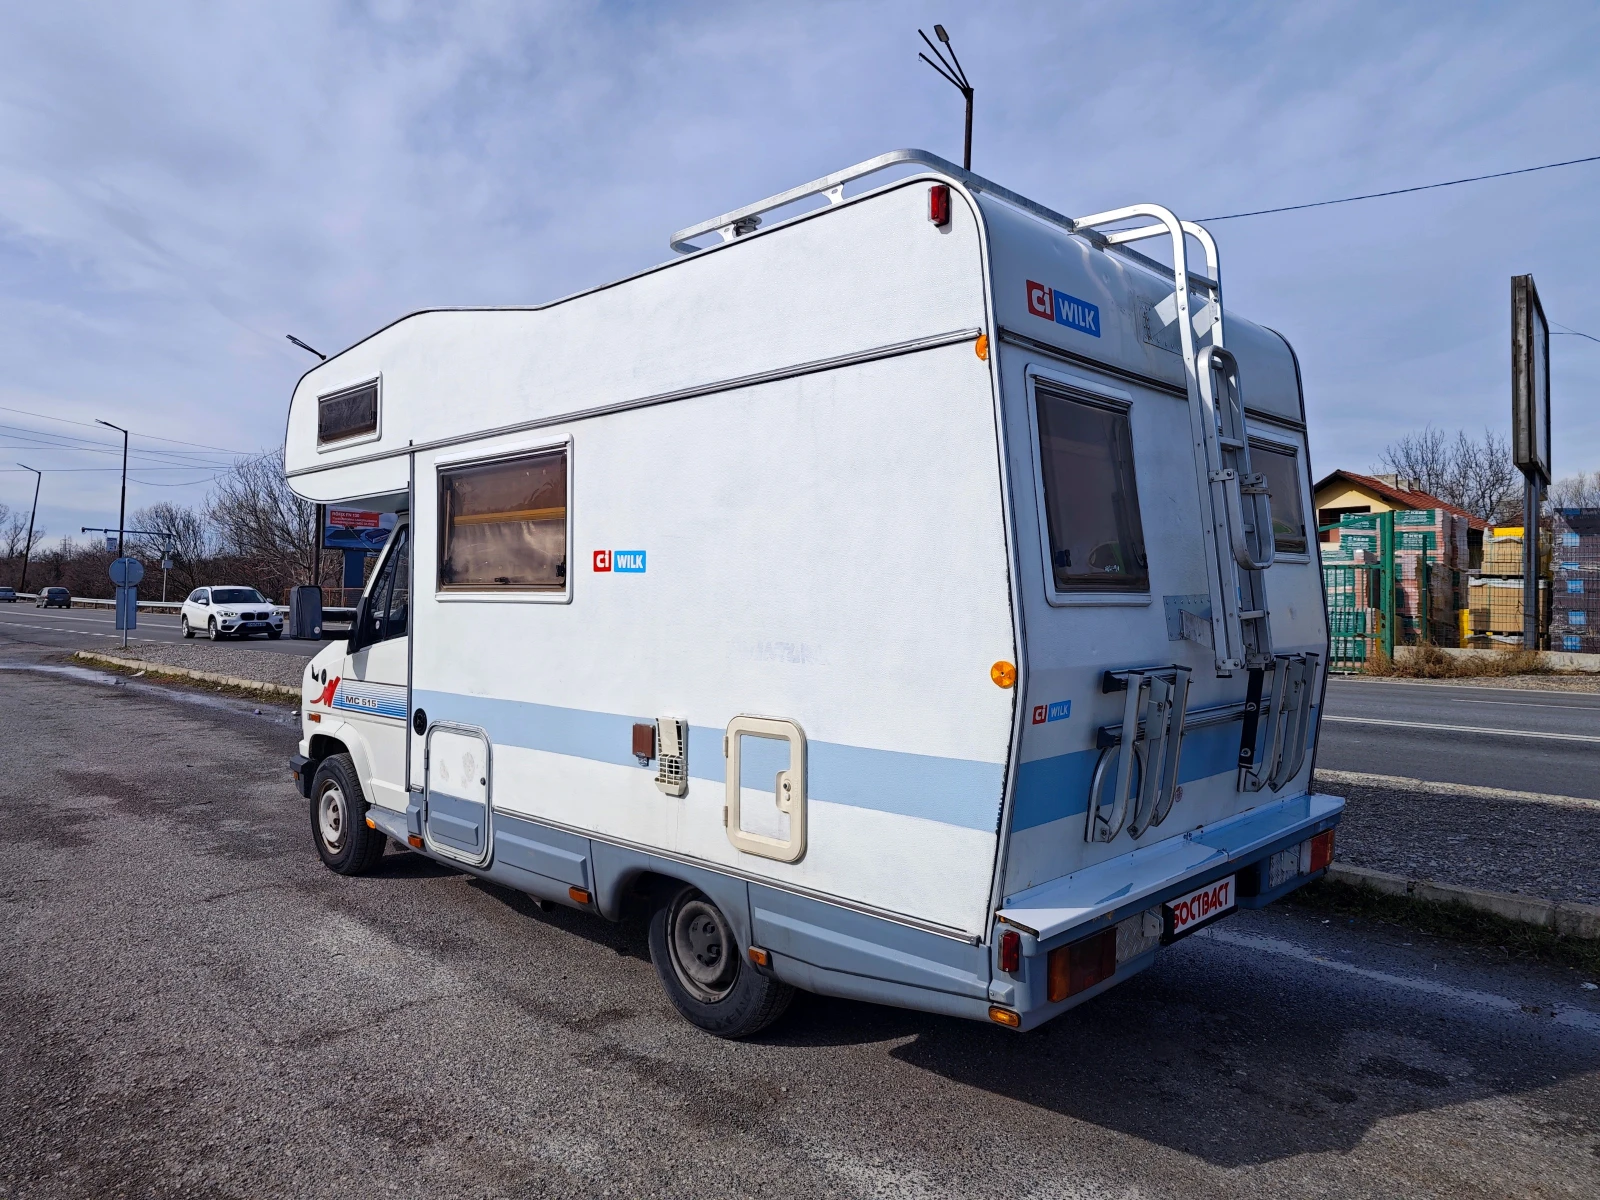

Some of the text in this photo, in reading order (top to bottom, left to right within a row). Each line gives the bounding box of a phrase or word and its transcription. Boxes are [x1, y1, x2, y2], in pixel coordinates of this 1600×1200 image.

[1058, 297, 1096, 331] WILK
[616, 554, 644, 569] WILK
[345, 695, 377, 708] MC 515
[1050, 704, 1069, 718] WILK
